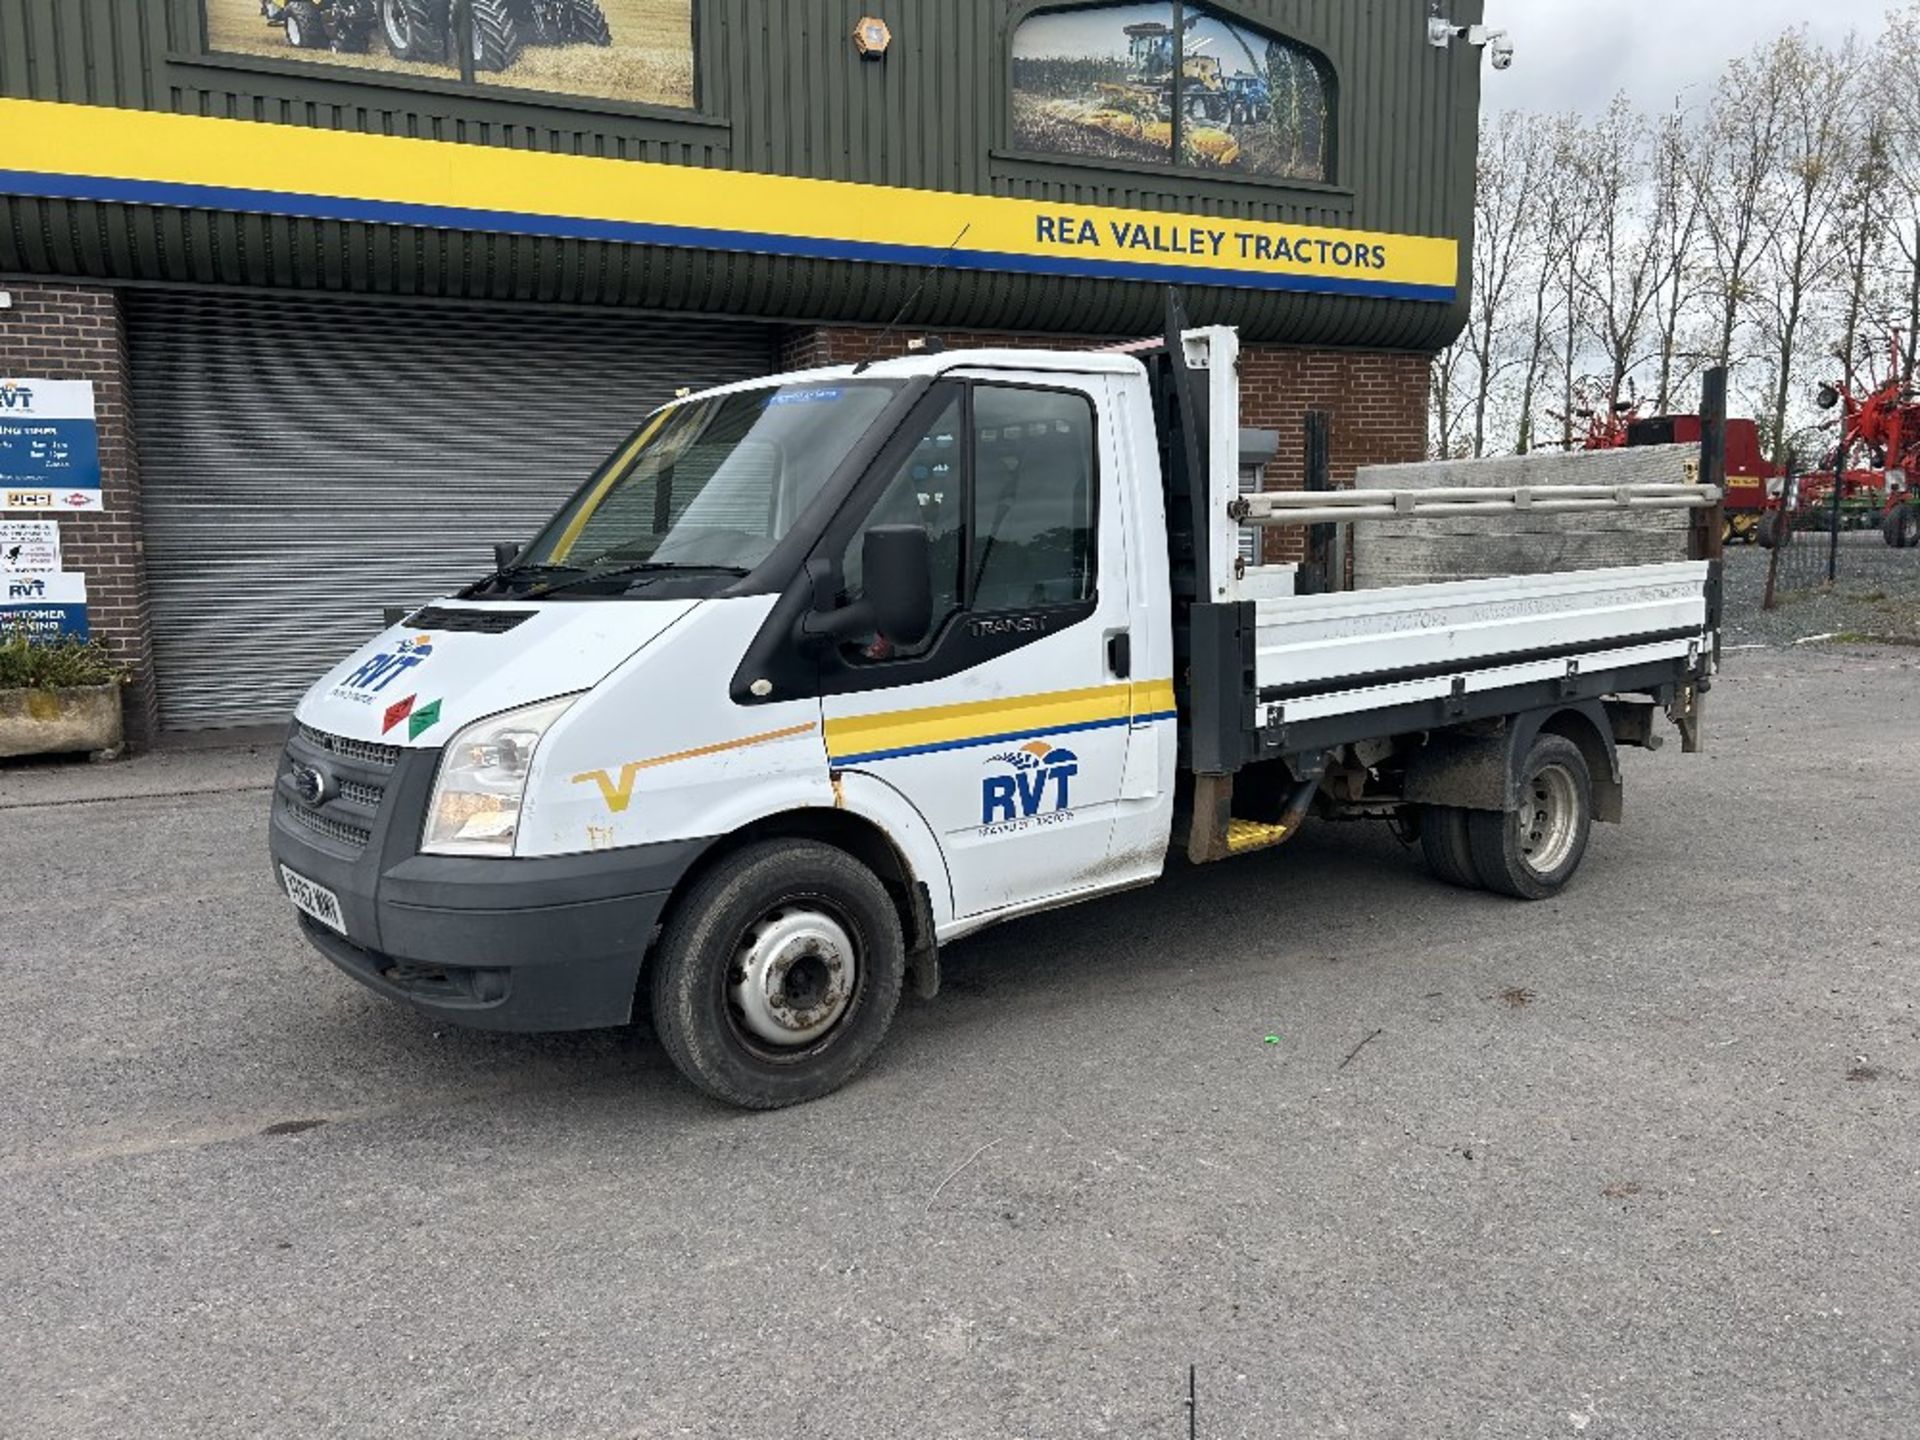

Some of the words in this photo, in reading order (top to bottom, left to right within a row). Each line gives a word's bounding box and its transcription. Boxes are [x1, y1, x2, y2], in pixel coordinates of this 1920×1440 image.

[1036, 214, 1100, 247] REA
[1110, 221, 1226, 256] VALLEY
[1234, 232, 1386, 269] TRACTORS
[9, 585, 45, 596] RVT
[966, 615, 1048, 637] TRANSIT
[340, 653, 424, 692] RVT
[982, 763, 1078, 825] RVT
